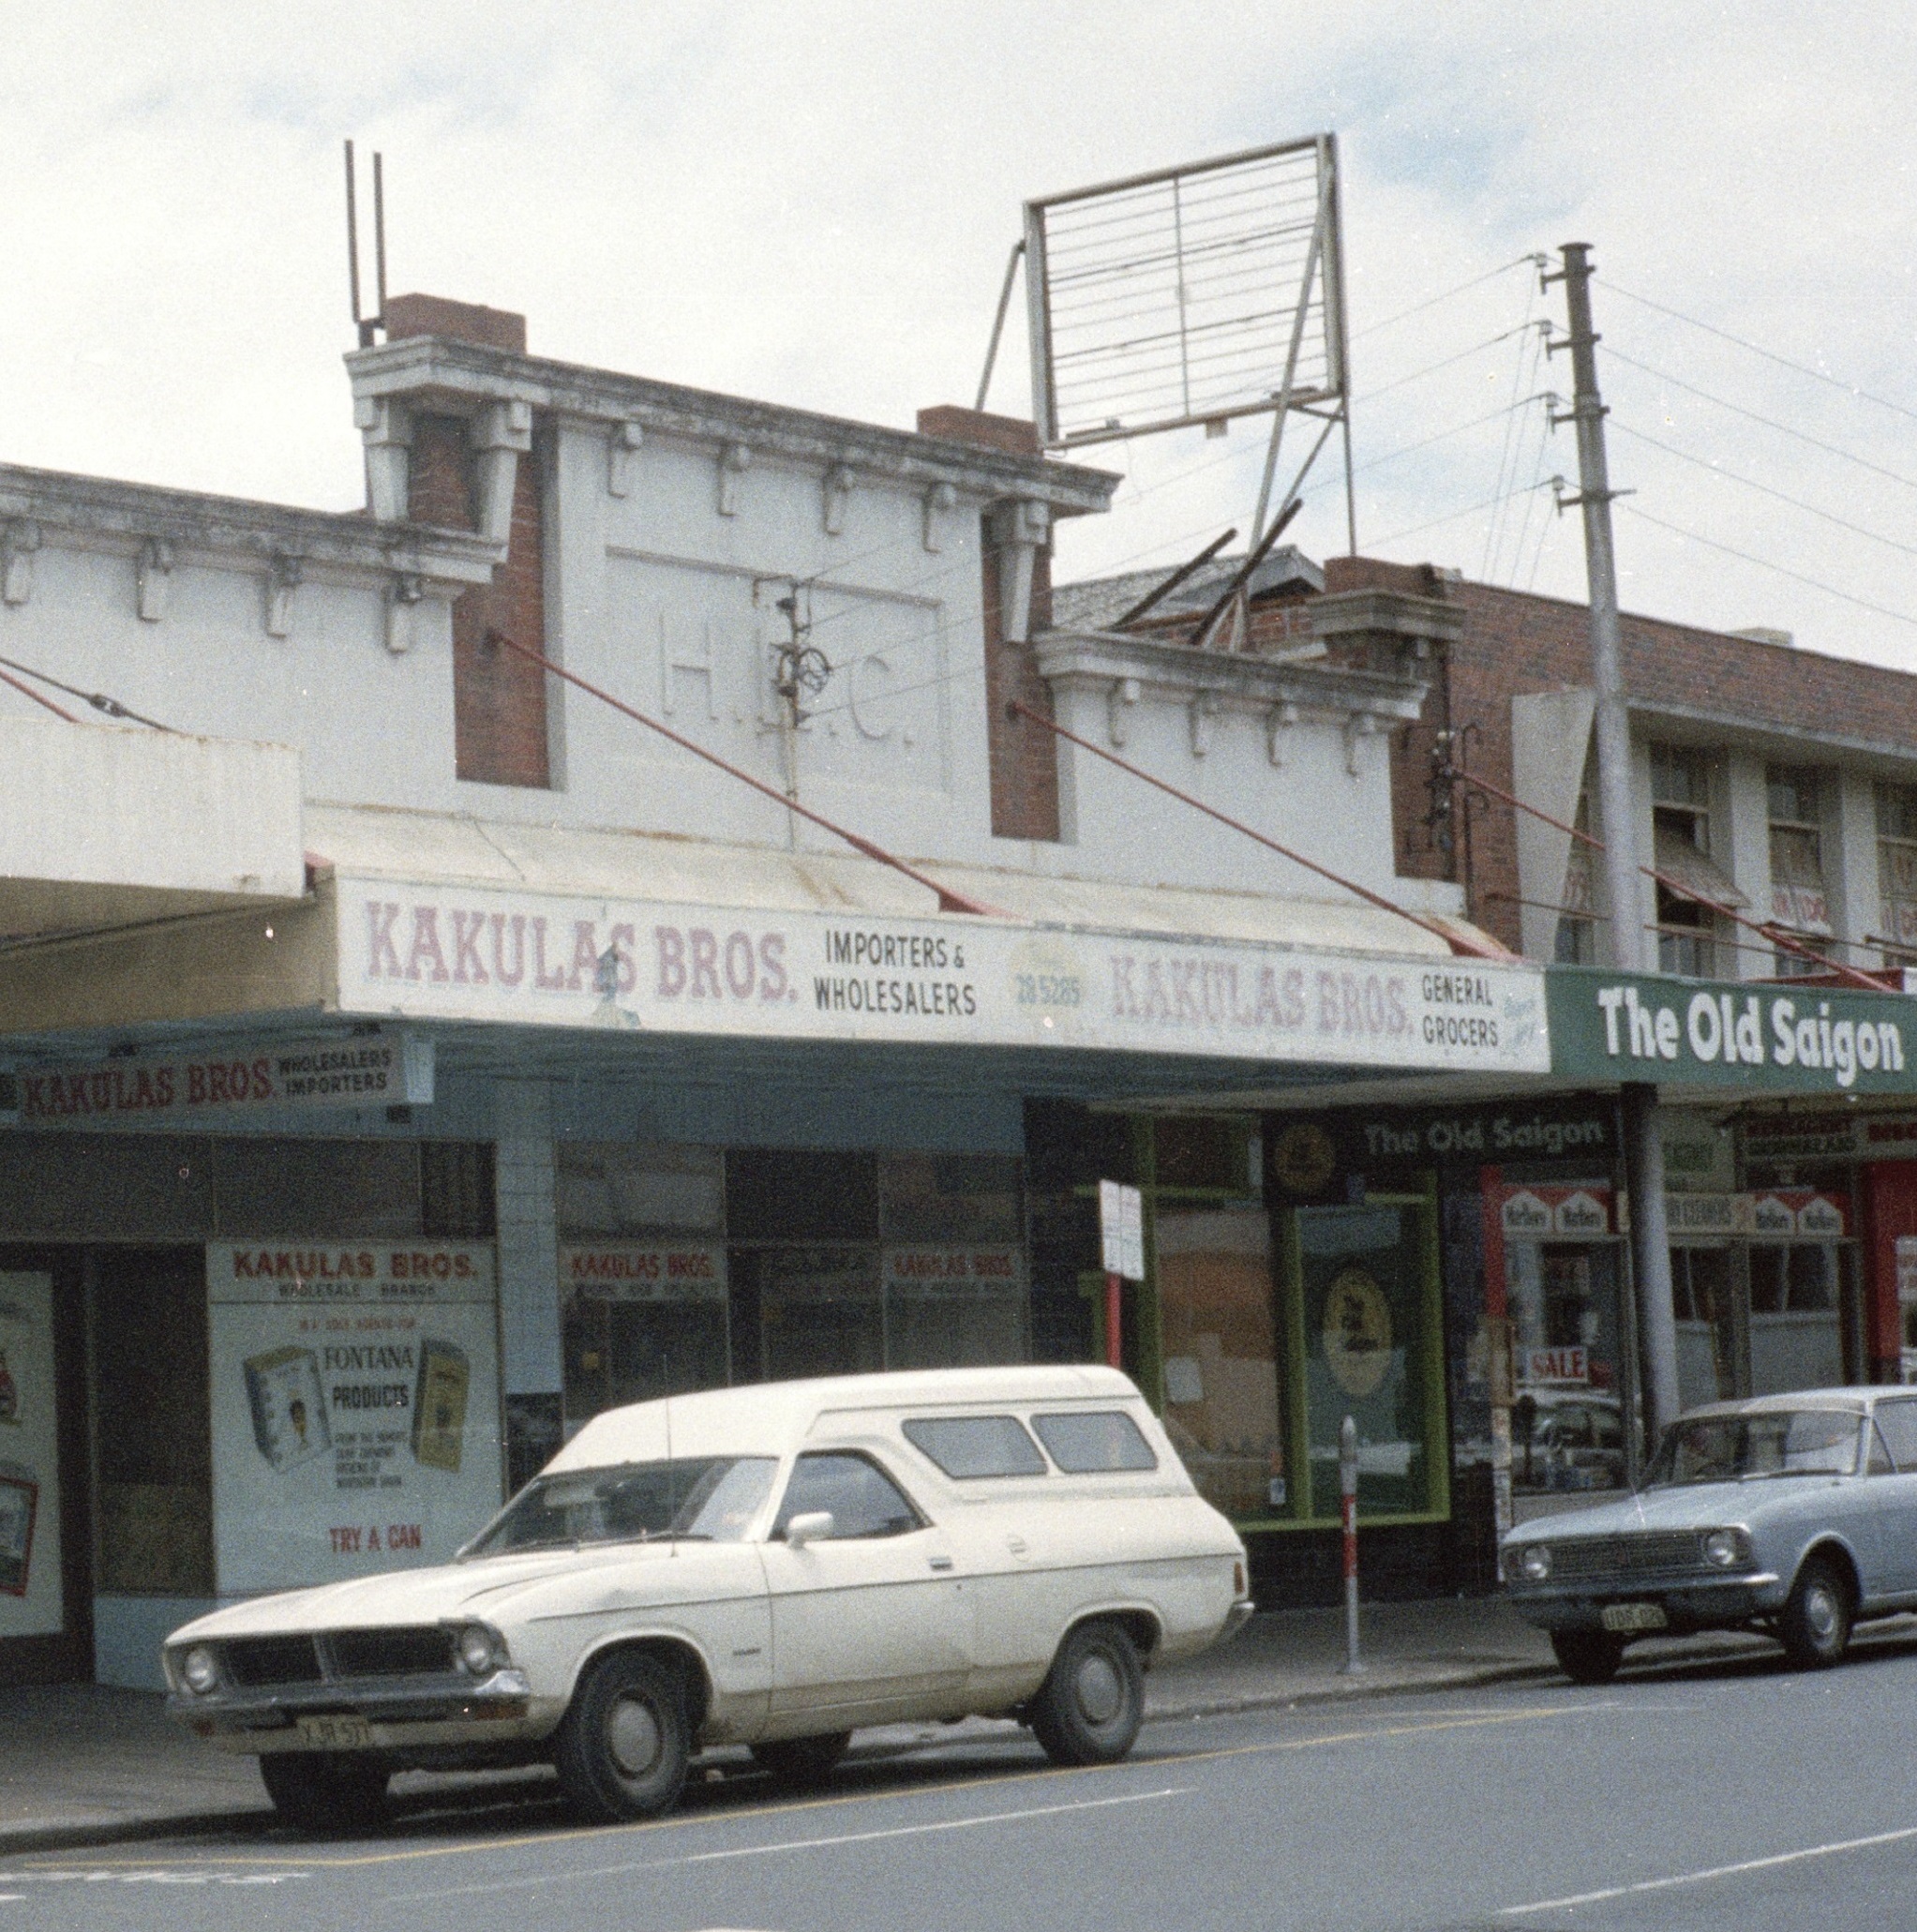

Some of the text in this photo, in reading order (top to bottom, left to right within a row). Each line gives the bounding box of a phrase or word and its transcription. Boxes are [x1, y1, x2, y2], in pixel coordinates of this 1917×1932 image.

[365, 900, 801, 1004] KAKULAS BROS.
[825, 929, 966, 969] IMPORTERS &
[813, 976, 978, 1016] WHOLESALERS
[1109, 955, 1303, 1029] KAKULAS
[1421, 972, 1494, 1008] GENERAL
[1421, 1013, 1500, 1048] GROCERS
[1597, 986, 1905, 1087] The Old Saigon
[278, 1048, 392, 1075] WHOLESALERS
[23, 1066, 176, 1116] KAKULAS
[285, 1071, 387, 1096] IMPORTERS
[1365, 1119, 1604, 1155] The Old Saigon
[233, 1251, 478, 1279] KAKULAS BROS.
[323, 1346, 414, 1370] FONTANA
[1531, 1350, 1586, 1381] SALE
[333, 1385, 410, 1409] PRODUCTS
[329, 1523, 422, 1553] TRY A CAN
